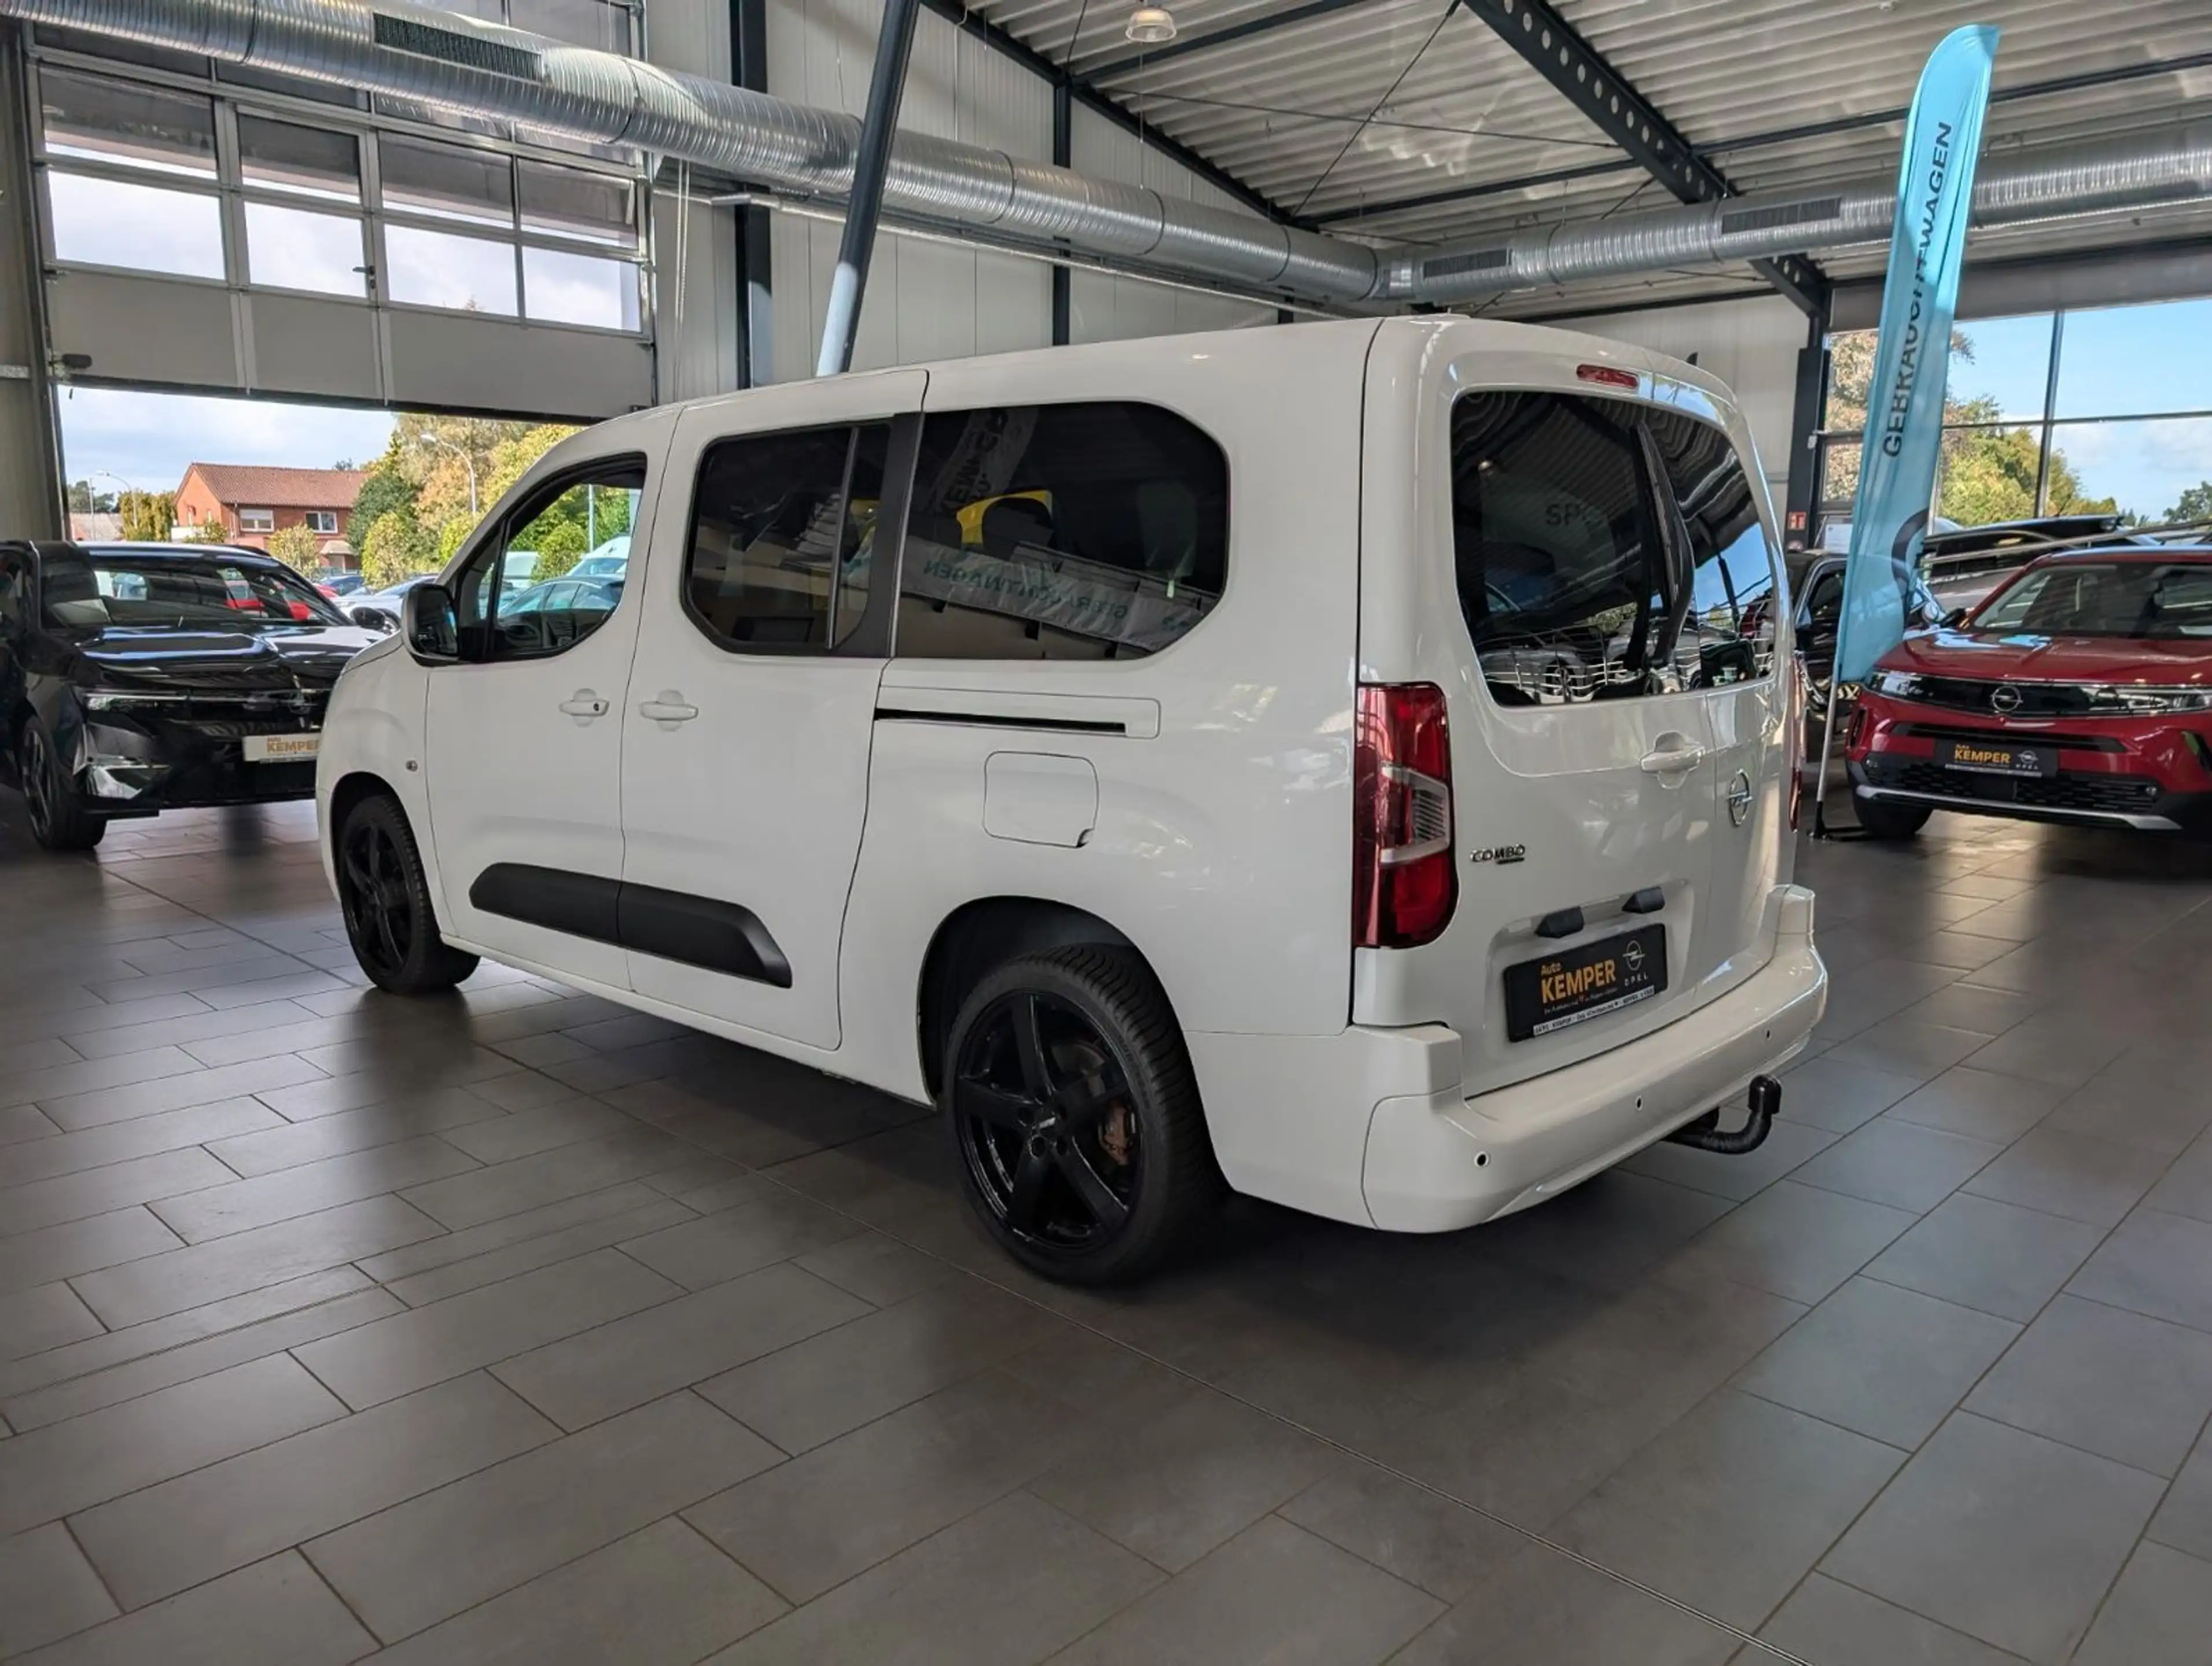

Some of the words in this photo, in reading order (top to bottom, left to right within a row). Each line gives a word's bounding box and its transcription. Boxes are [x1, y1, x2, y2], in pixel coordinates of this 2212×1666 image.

[1955, 749, 2011, 764] KEMPER
[1470, 844, 1526, 863] COMBO
[1541, 961, 1562, 976] Auto
[1541, 959, 1616, 1004] KEMPER
[1624, 972, 1649, 987] OPEL
